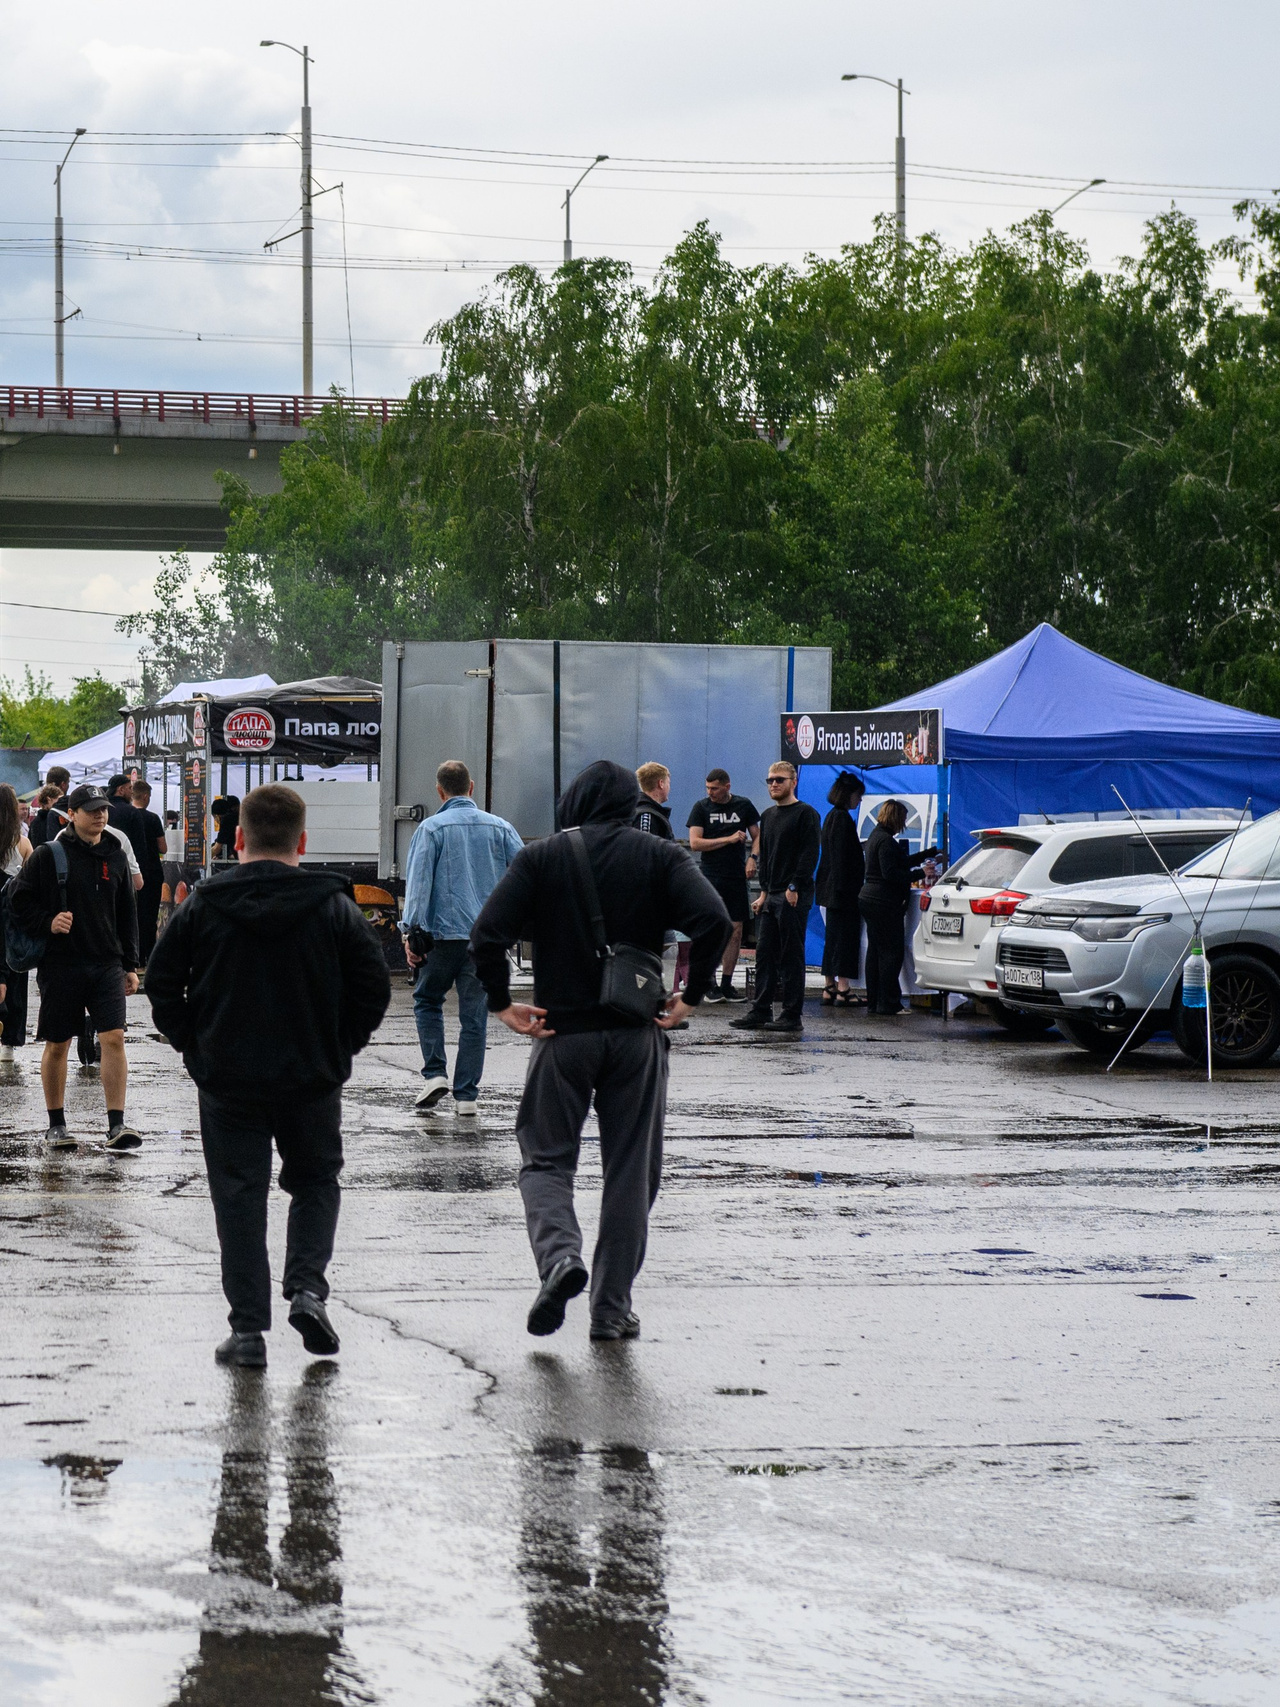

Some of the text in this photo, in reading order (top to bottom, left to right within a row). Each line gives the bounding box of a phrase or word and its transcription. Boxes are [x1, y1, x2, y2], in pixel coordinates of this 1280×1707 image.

[231, 716, 268, 730] ПАПА
[284, 718, 382, 736] Папа лю
[231, 727, 269, 739] любит
[236, 738, 264, 747] МЯСО
[817, 724, 905, 755] Ягода Байкала
[709, 812, 741, 824] FILA
[1030, 970, 1041, 981] 138
